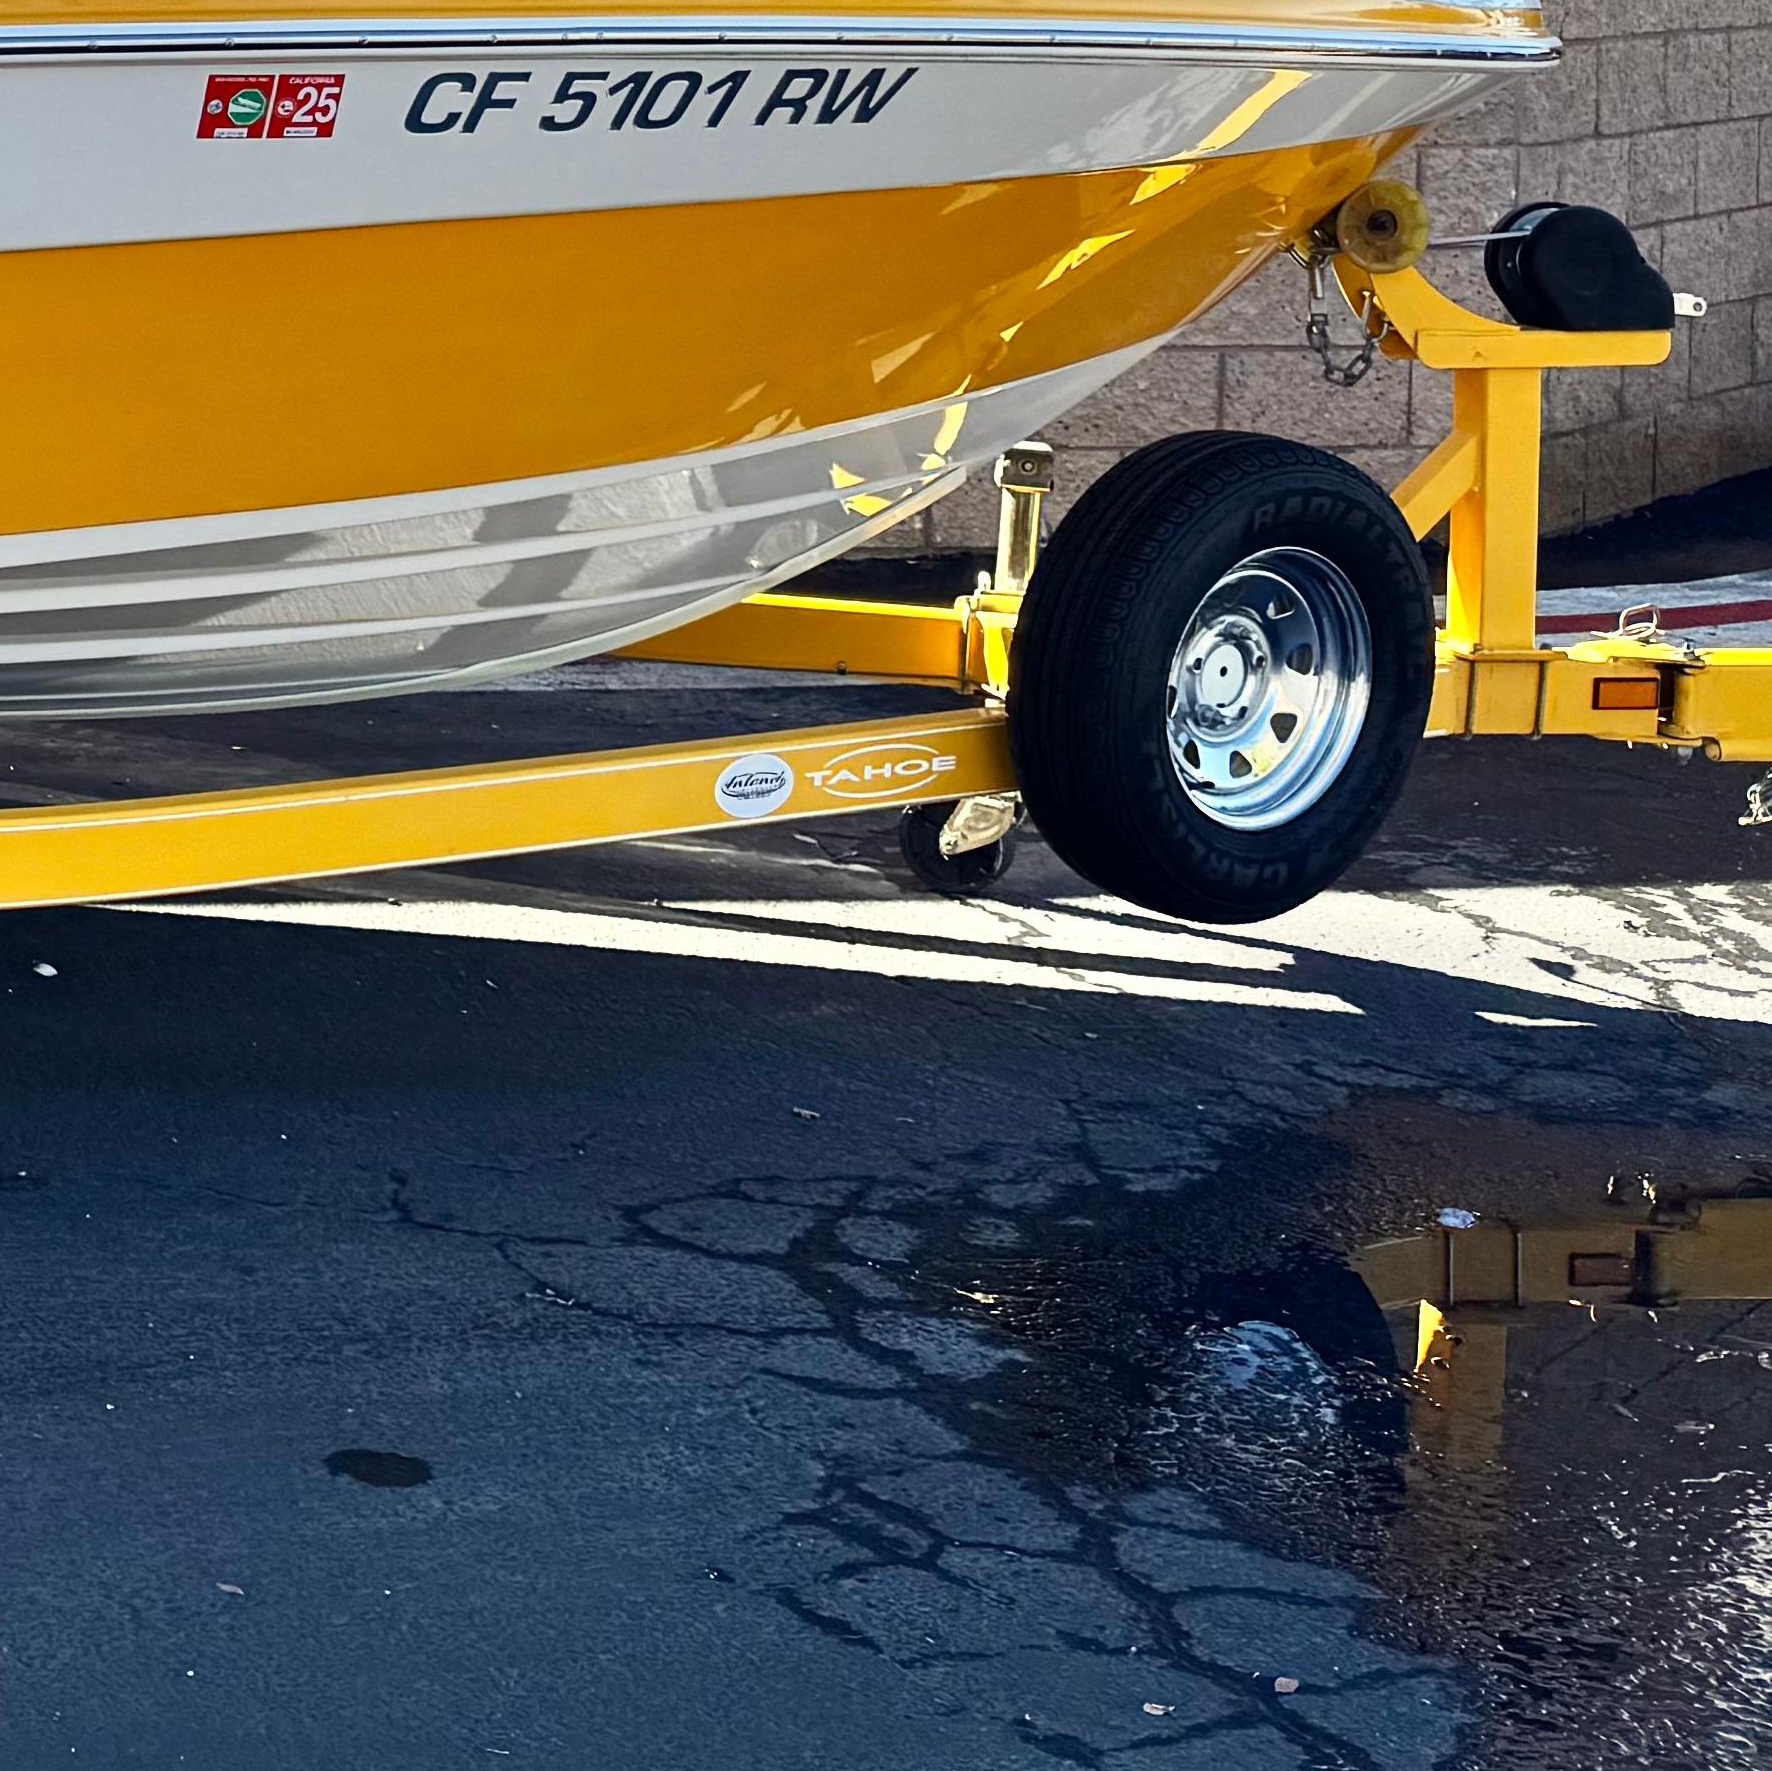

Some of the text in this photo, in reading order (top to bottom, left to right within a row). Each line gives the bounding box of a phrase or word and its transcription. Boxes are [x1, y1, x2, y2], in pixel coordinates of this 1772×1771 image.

[291, 86, 340, 123] 25
[404, 67, 920, 133] CF 5101 RW
[804, 755, 956, 787] TAHOE
